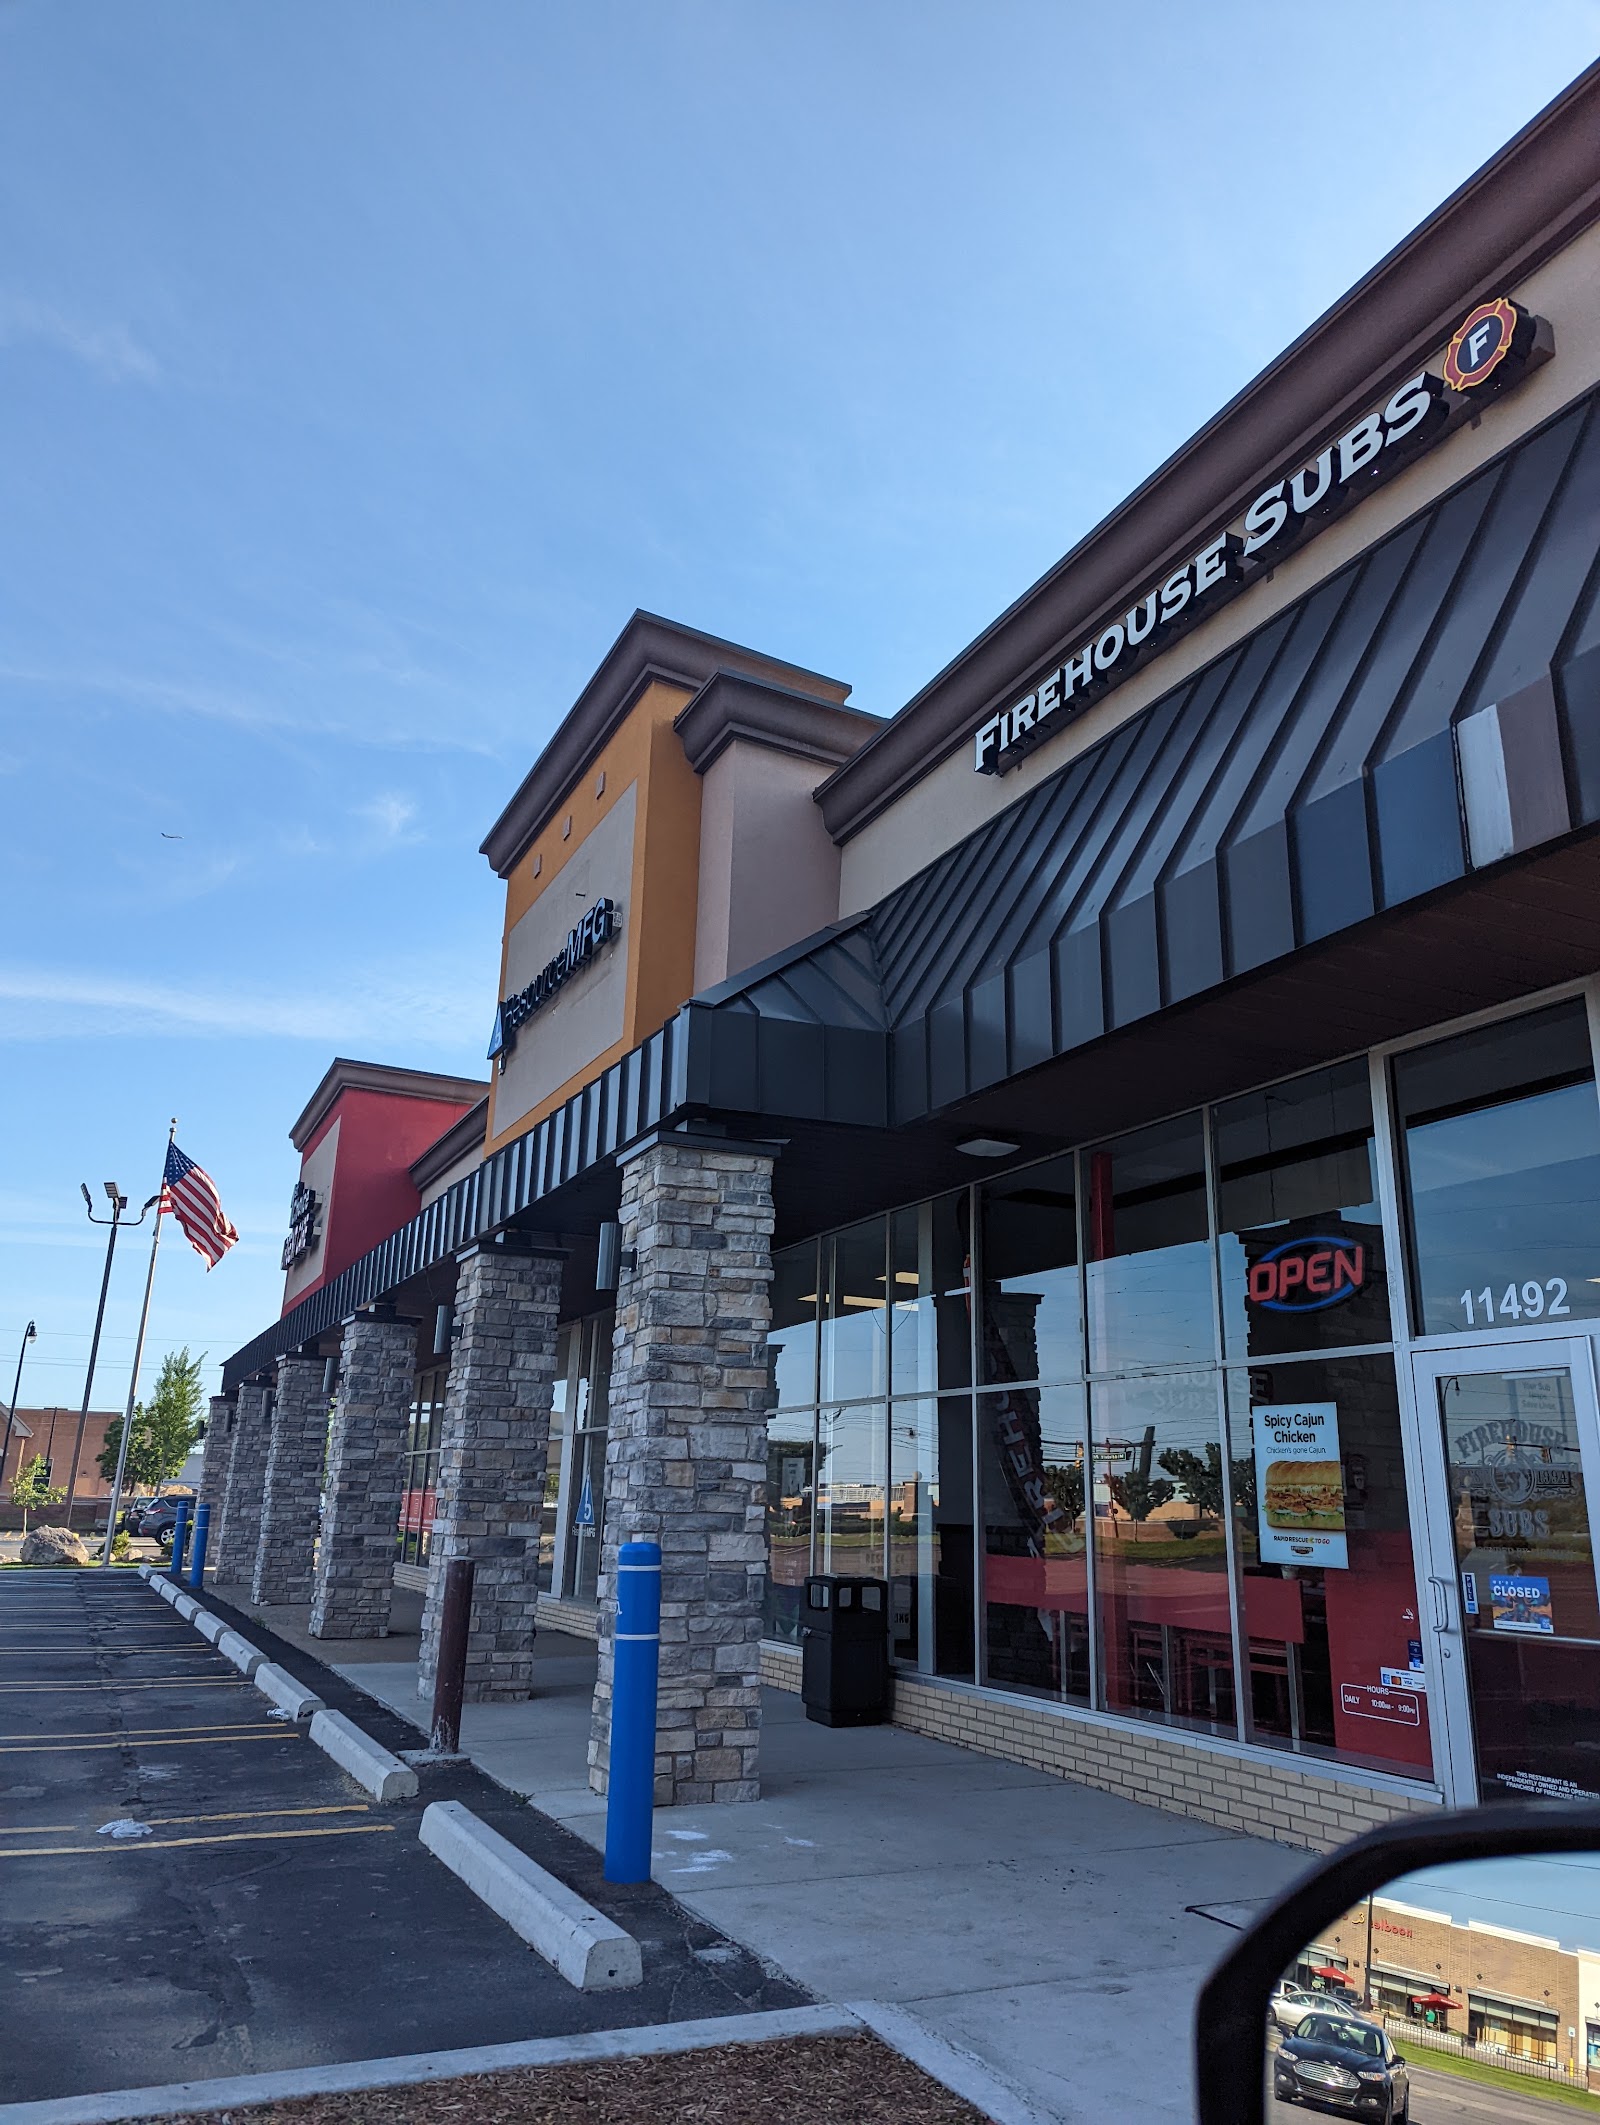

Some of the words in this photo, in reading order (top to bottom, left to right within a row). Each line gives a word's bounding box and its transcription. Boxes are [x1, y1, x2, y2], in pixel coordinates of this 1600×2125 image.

[1467, 322, 1490, 367] F
[973, 531, 1229, 773] FIREHOUSE
[1244, 371, 1432, 558] SUBS
[1249, 1246, 1363, 1302] OPEN
[1460, 1277, 1571, 1325] 11492
[1264, 1414, 1292, 1429] Spicy
[1294, 1412, 1325, 1428] Cajun
[1274, 1430, 1316, 1443] Chicken
[1454, 1420, 1568, 1459] FIREHOUSE
[1266, 1446, 1292, 1454] Chicken's
[1293, 1447, 1307, 1455] gone
[1537, 1471, 1568, 1484] 1994
[1487, 1508, 1550, 1538] SUBS
[1493, 1585, 1540, 1599] CLOSED
[1344, 1694, 1360, 1704] DAILY
[1366, 1685, 1390, 1696] HOURS
[1496, 1773, 1538, 1787] INDEPENDENTLY
[1538, 1781, 1558, 1790] OWNED
[1570, 1787, 1600, 1800] OPERATED
[1516, 1770, 1528, 1779] THIS
[1528, 1773, 1563, 1785] RESTAURANT
[1506, 1781, 1535, 1793] FRANCHISE
[1535, 1786, 1543, 1794] OF
[1543, 1788, 1574, 1801] FIREHOUSE
